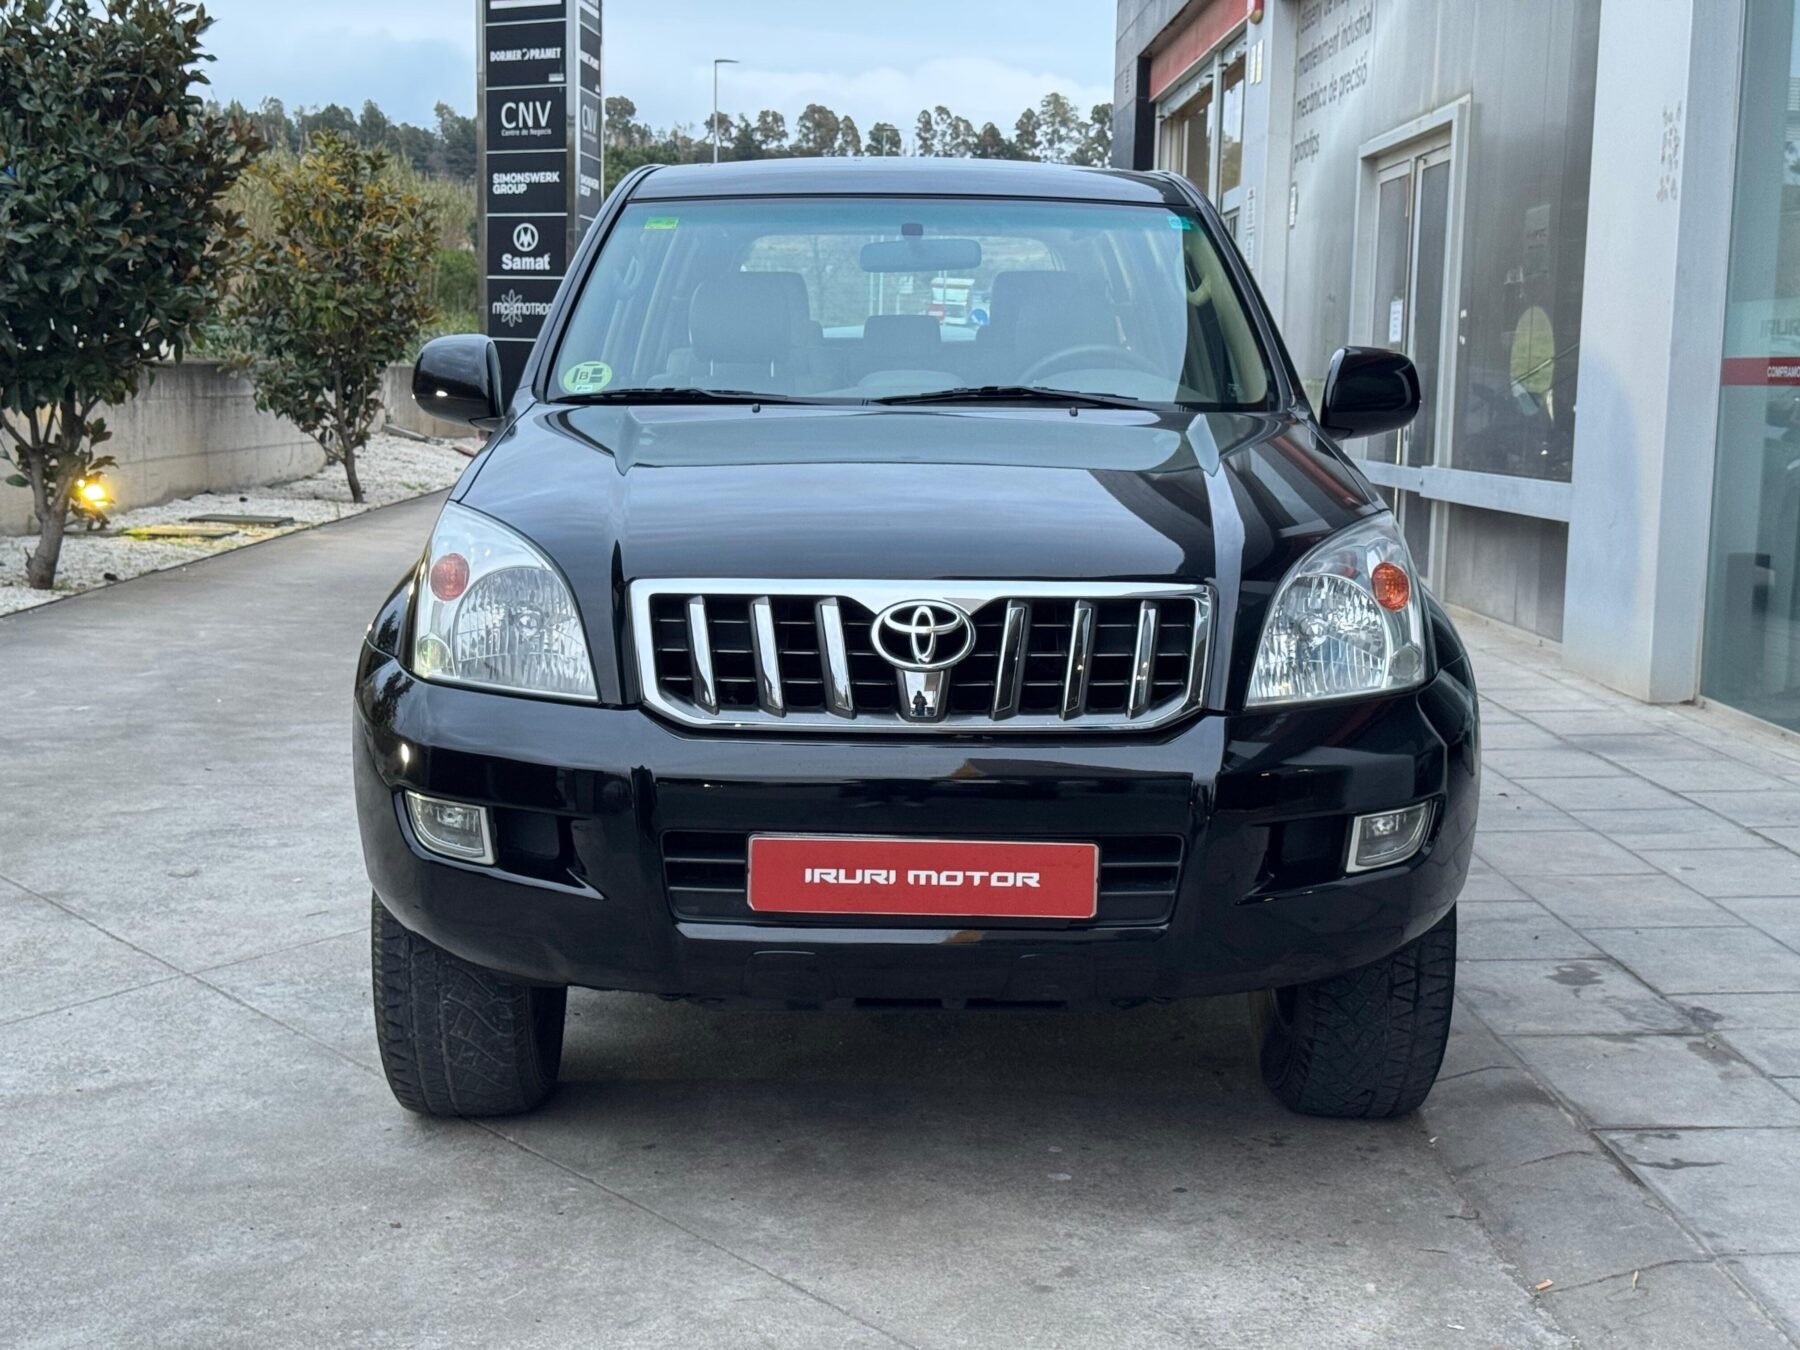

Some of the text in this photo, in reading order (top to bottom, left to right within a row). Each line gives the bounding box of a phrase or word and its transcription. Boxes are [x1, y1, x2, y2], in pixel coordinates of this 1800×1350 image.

[489, 49, 522, 62] DORMER
[501, 100, 551, 129] CNV
[492, 171, 560, 184] SIMONSWERK
[492, 183, 528, 195] GROUP
[501, 252, 551, 271] Samat
[804, 868, 1041, 888] IRURI MOTOR
